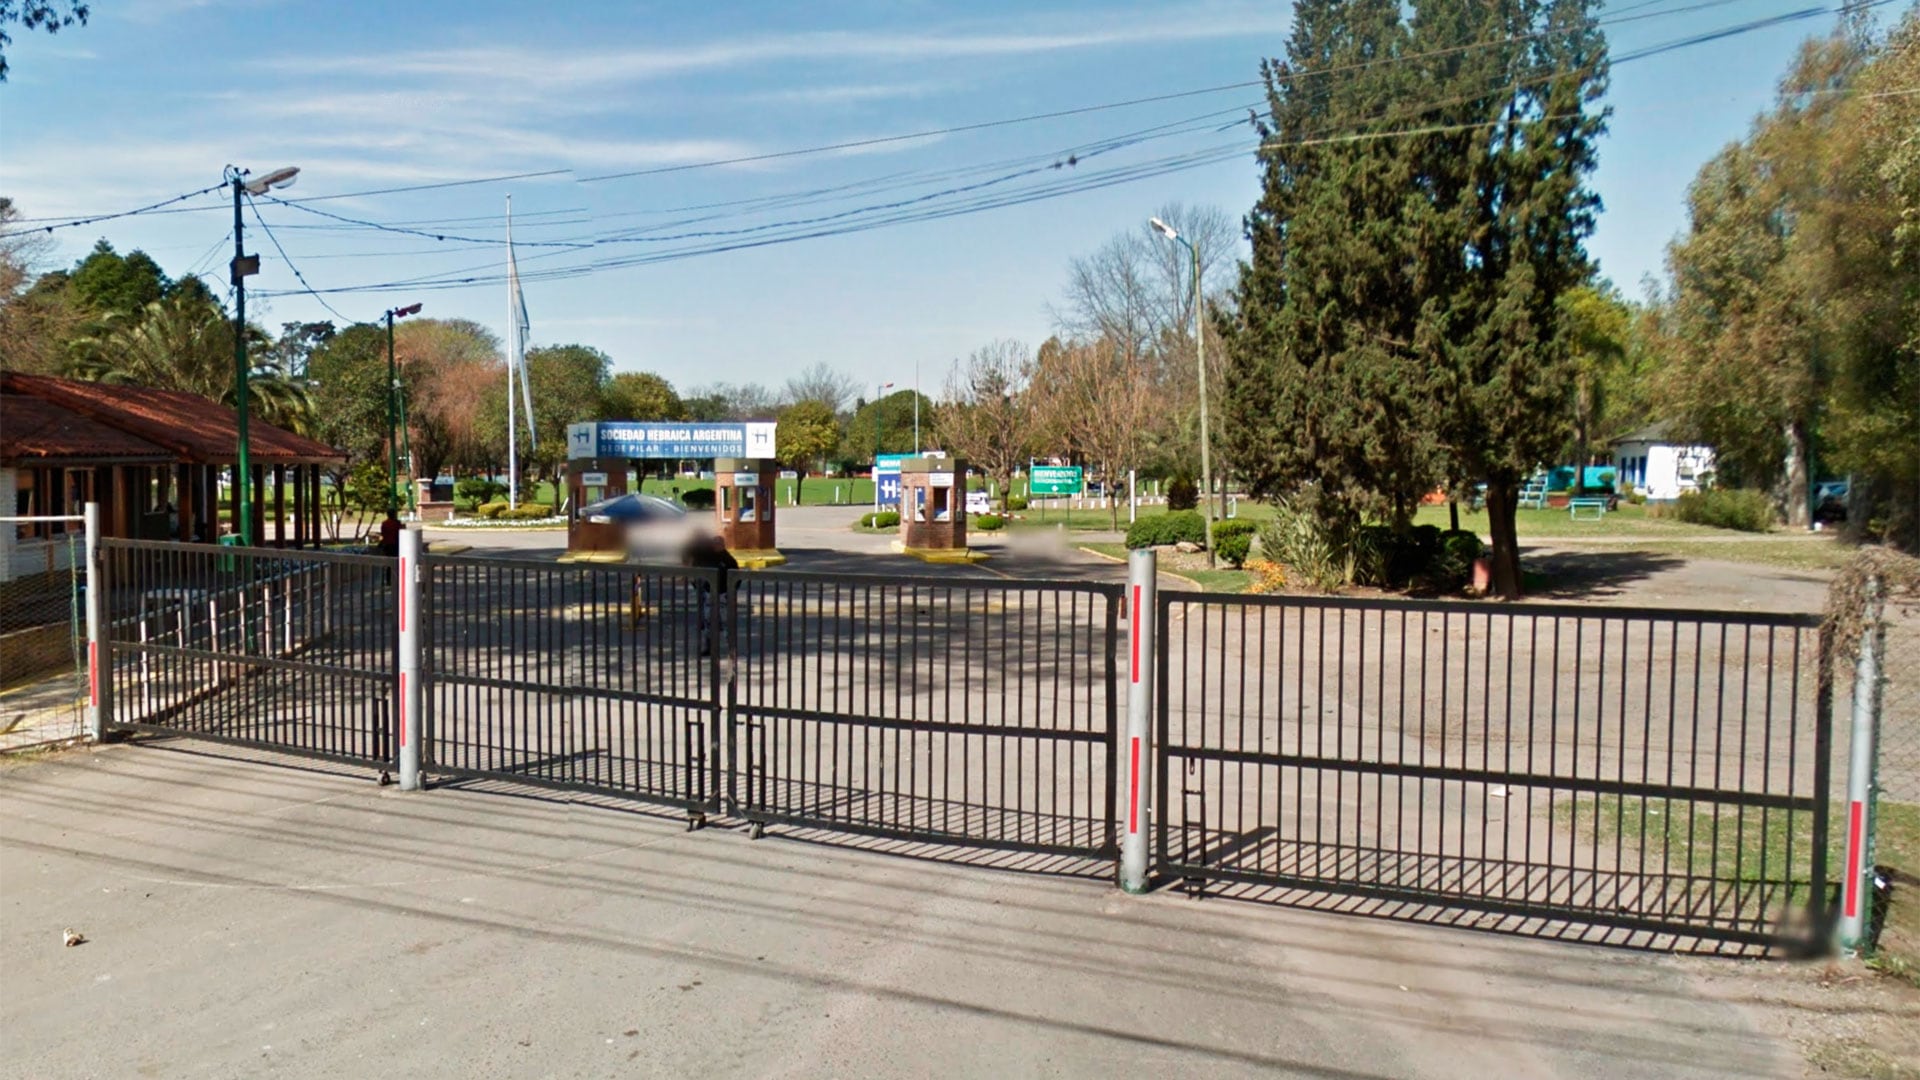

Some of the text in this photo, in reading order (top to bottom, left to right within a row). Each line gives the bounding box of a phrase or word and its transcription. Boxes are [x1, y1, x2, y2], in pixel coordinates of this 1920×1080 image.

[601, 429, 743, 440] SOCIEDAD HEBRAICA ARGENTINA
[601, 444, 625, 452] SEDE
[629, 444, 660, 452] PILAR
[673, 444, 743, 453] BIENVENIDOS
